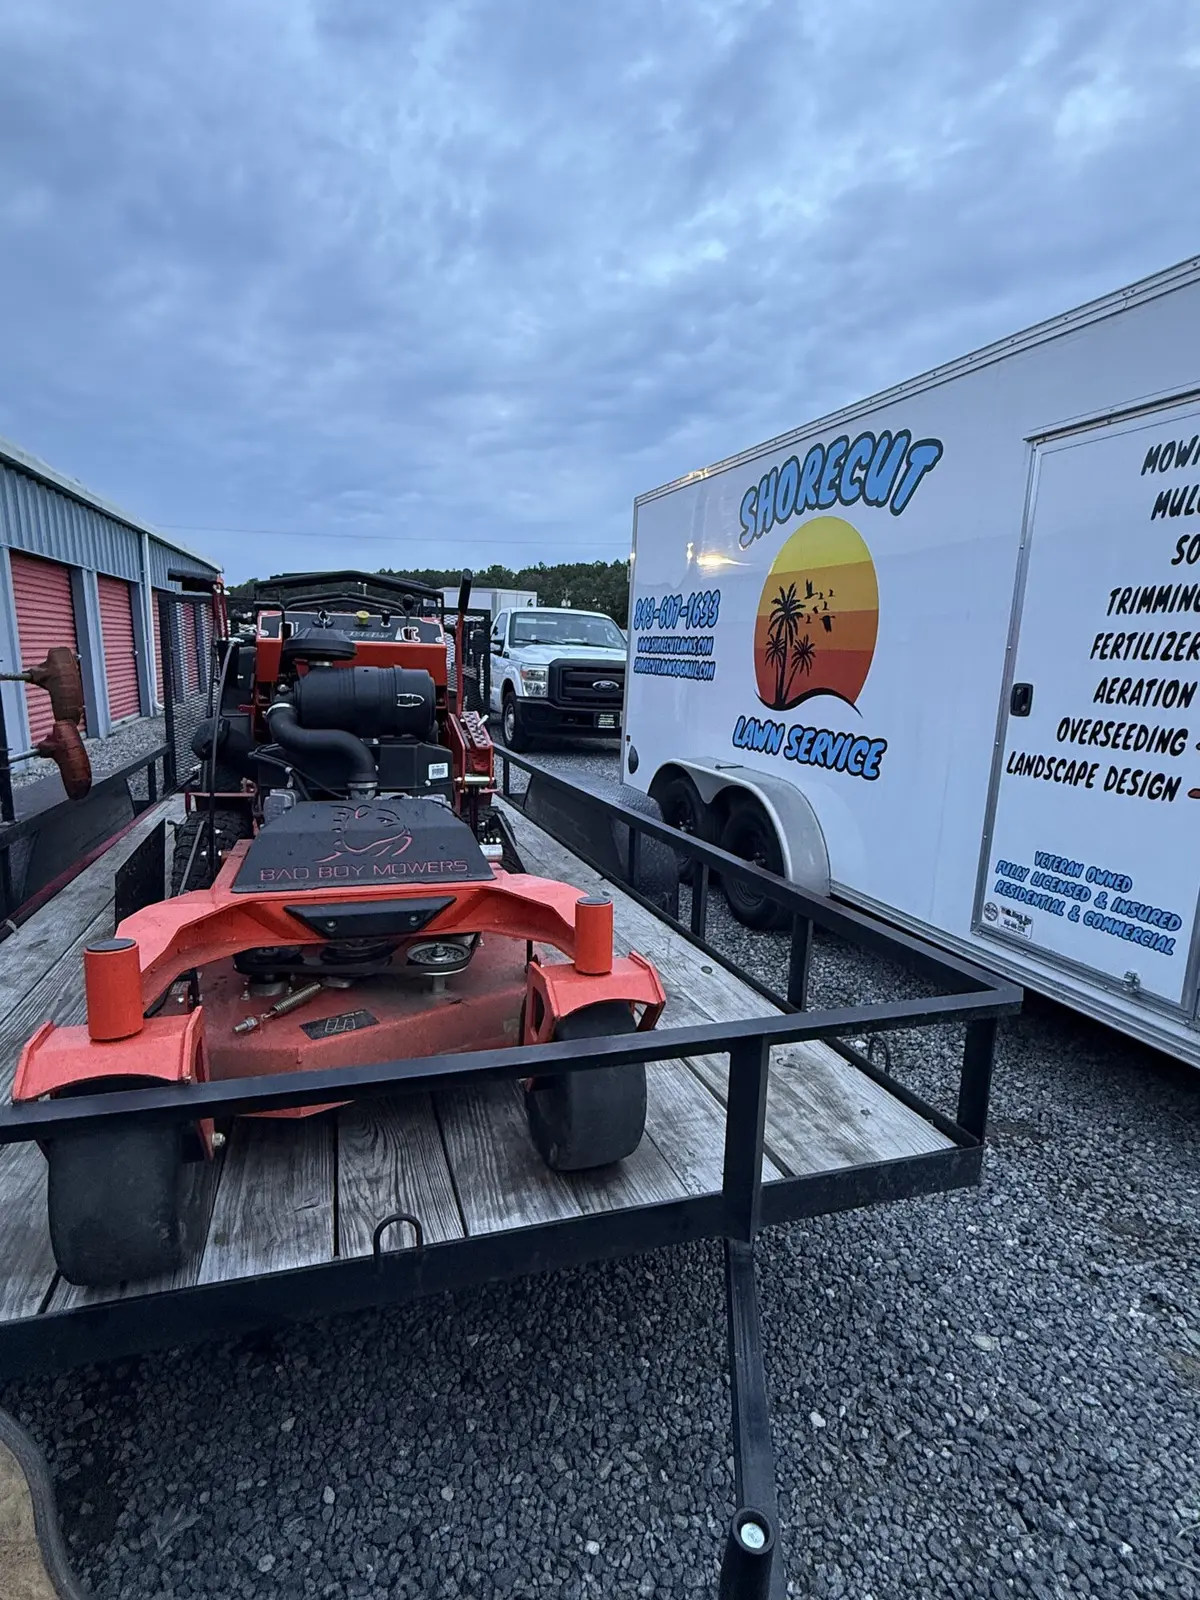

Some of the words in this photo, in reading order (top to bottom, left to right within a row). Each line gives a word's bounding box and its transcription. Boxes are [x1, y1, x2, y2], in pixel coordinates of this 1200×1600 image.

[739, 429, 943, 550] SHORECUT
[1150, 484, 1200, 521] MUL
[634, 589, 720, 631] 843-607-1633
[1093, 676, 1198, 709] AERATION
[732, 716, 785, 756] LAWN
[784, 728, 888, 780] SERVICE
[1056, 717, 1189, 757] OVERSEEDING
[1006, 750, 1100, 789] LANDSCAPE
[1103, 765, 1182, 802] DESIGN
[260, 867, 310, 882] BAD
[318, 865, 365, 879] BOY
[373, 860, 469, 877] MOWERS
[1034, 850, 1085, 878] VETERAN
[1085, 866, 1133, 893] OWNED
[995, 860, 1030, 882] FULLY
[1030, 871, 1092, 902] LICENSED
[1093, 891, 1108, 909] &
[1110, 897, 1182, 932] INSURED
[994, 880, 1065, 917] RESIDENTIAL
[1067, 905, 1081, 924] &
[1083, 910, 1177, 956] COMMERCIAL
